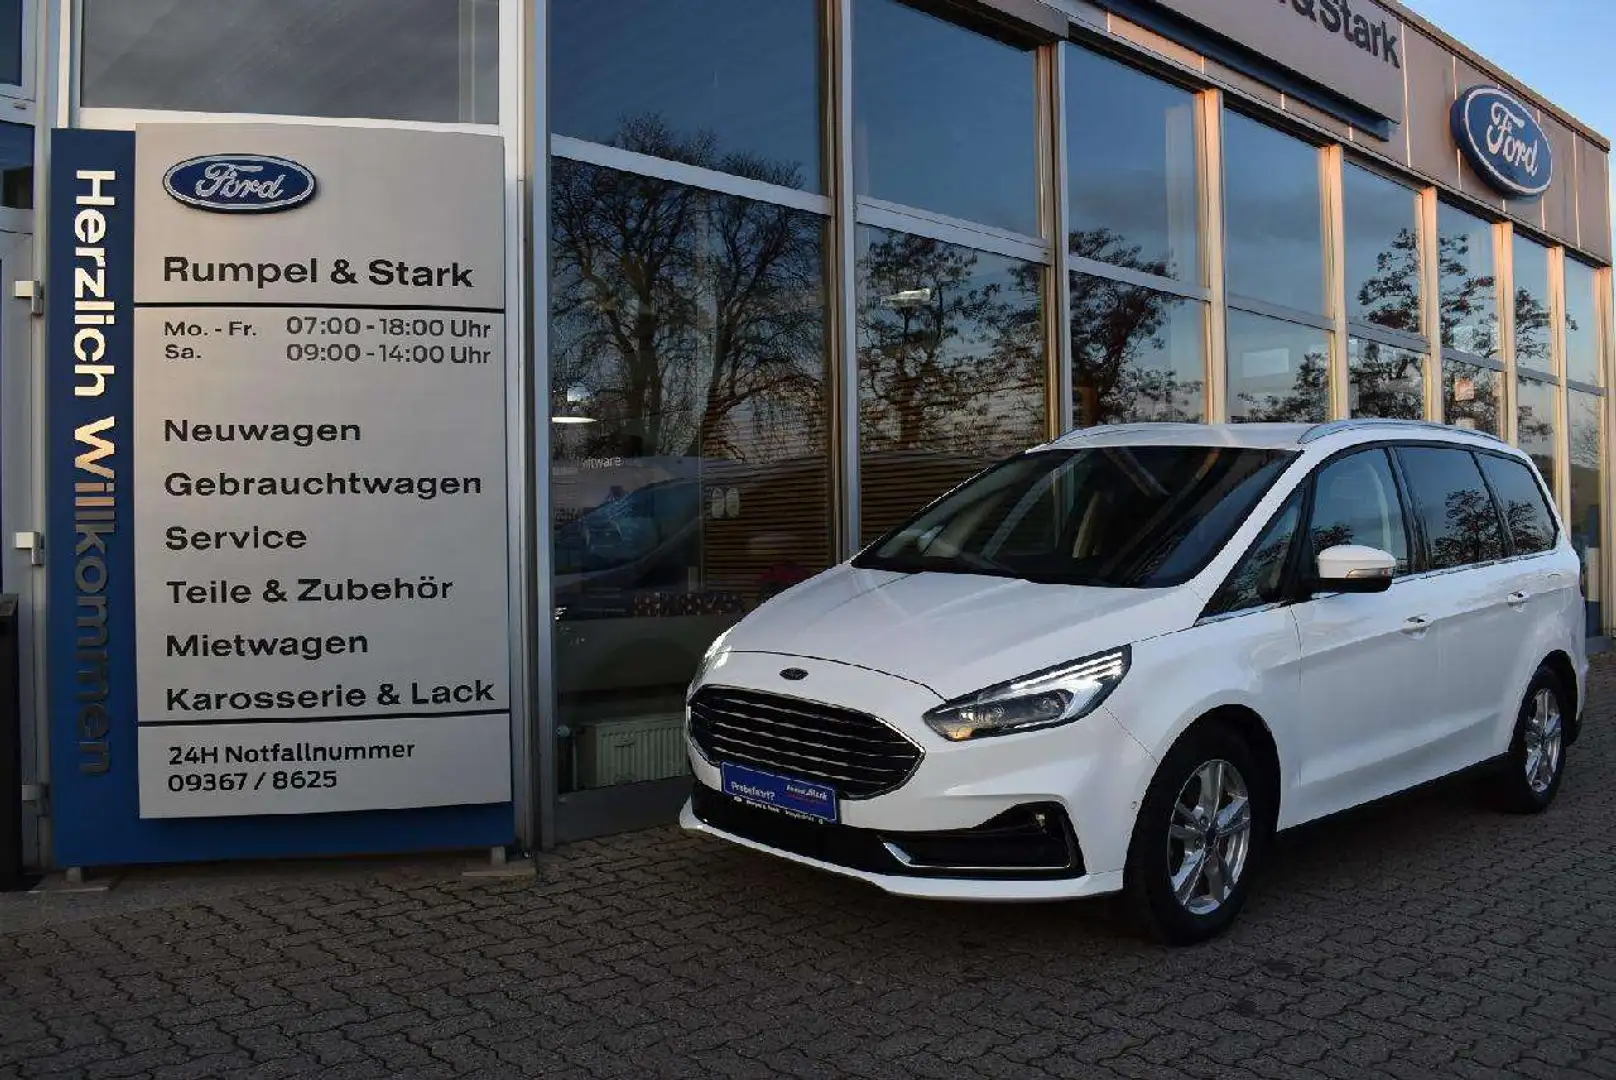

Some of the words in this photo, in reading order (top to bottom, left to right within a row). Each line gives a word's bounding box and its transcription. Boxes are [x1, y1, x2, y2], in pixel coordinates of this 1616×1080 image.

[1487, 101, 1538, 176] Ford
[195, 162, 286, 199] Ford
[74, 170, 116, 396] Herzlich
[164, 257, 317, 288] Rumpel
[330, 259, 358, 284] &
[369, 259, 475, 287] Stark
[164, 321, 208, 336] Mo.
[229, 321, 257, 336] Fr.
[450, 319, 491, 339] Uhr
[165, 344, 202, 360] Sa.
[450, 345, 492, 364] Uhr
[164, 420, 361, 447] Neuwagen
[164, 472, 482, 500] Gebrauchtwagen
[165, 526, 307, 550] Service
[74, 415, 115, 776] Willkommen
[167, 580, 252, 603] Teile
[263, 579, 288, 604] &
[298, 576, 454, 602] Zubehör
[167, 634, 369, 661] Mietwagen
[167, 684, 367, 711] Karosserie
[377, 683, 401, 706] &
[411, 679, 496, 705] Lack
[168, 746, 219, 766] 24H
[225, 742, 416, 764] Notfallnummer
[168, 772, 249, 793] 09367
[253, 771, 267, 791] /
[273, 770, 337, 790] 8625
